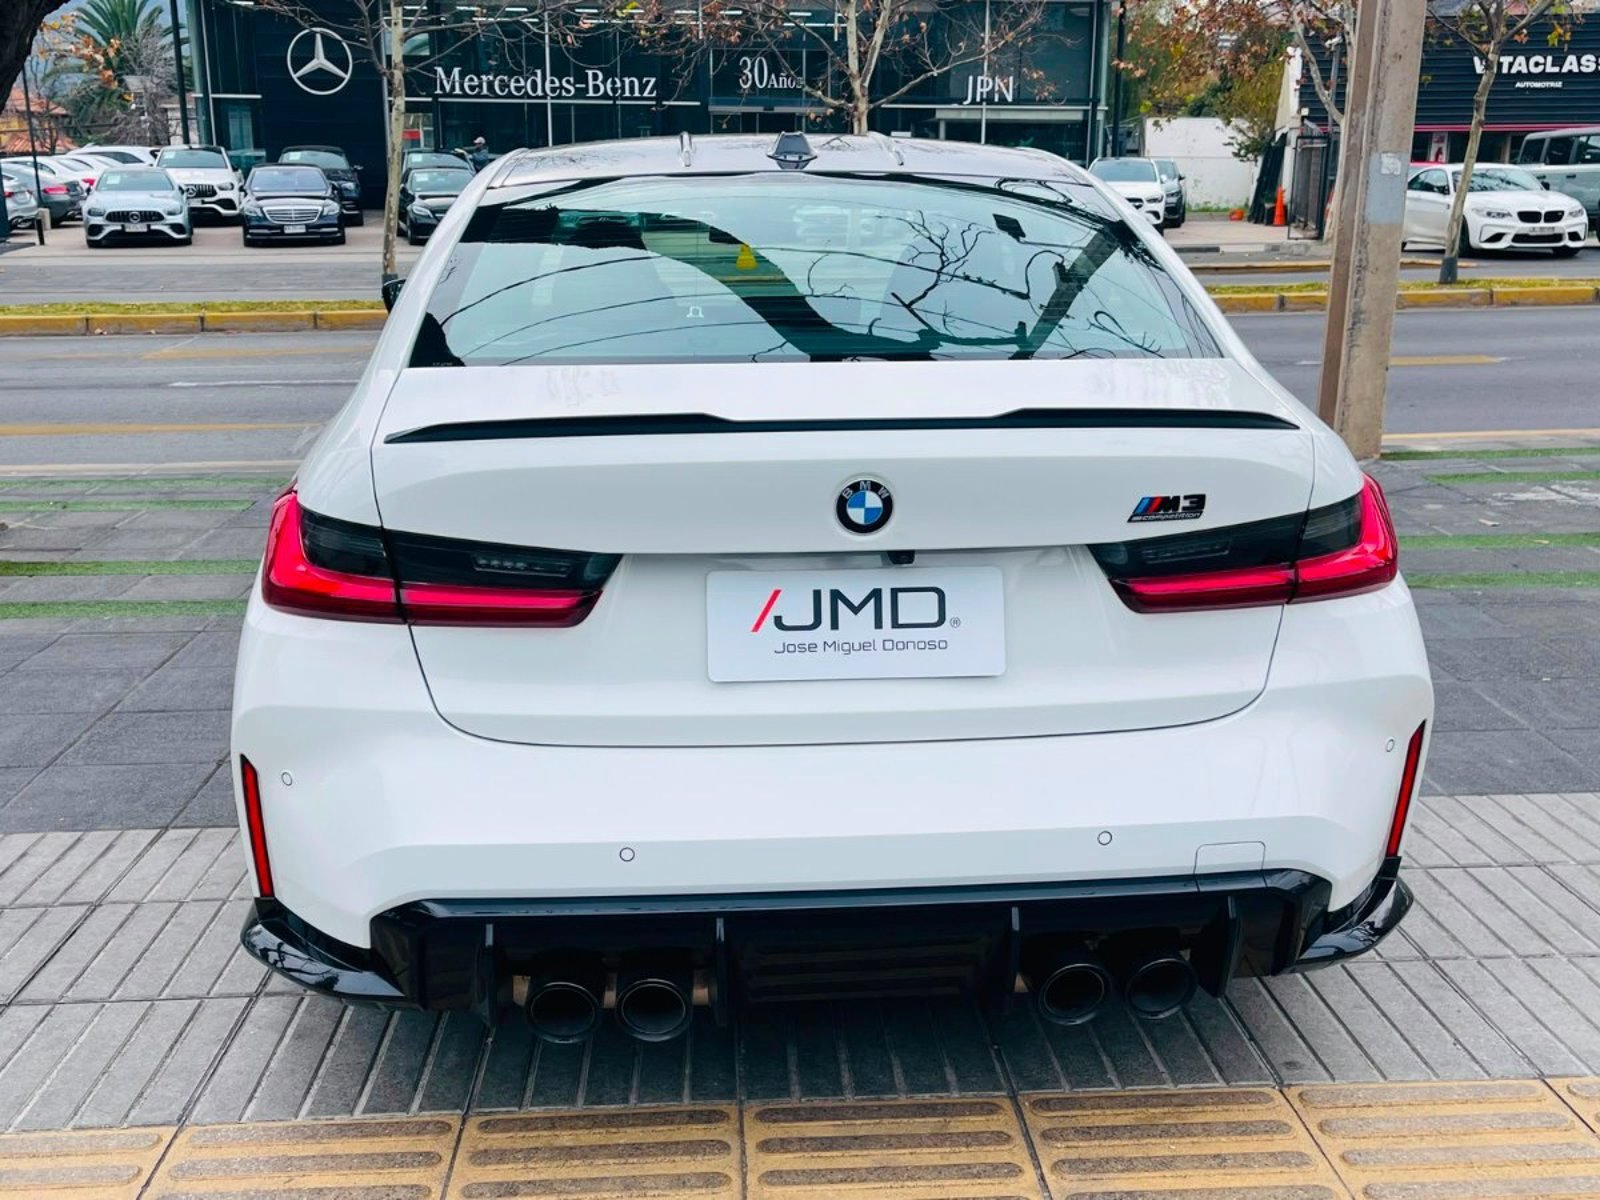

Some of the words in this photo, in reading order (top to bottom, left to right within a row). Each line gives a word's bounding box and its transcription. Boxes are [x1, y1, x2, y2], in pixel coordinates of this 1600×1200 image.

[1473, 54, 1600, 74] VTACLAS
[434, 67, 657, 97] Mercedes-Benz
[962, 75, 1014, 105] JPN
[842, 480, 889, 499] BMW
[774, 641, 818, 654] Jose
[823, 639, 877, 656] Miguel
[883, 638, 948, 652] Donoso
